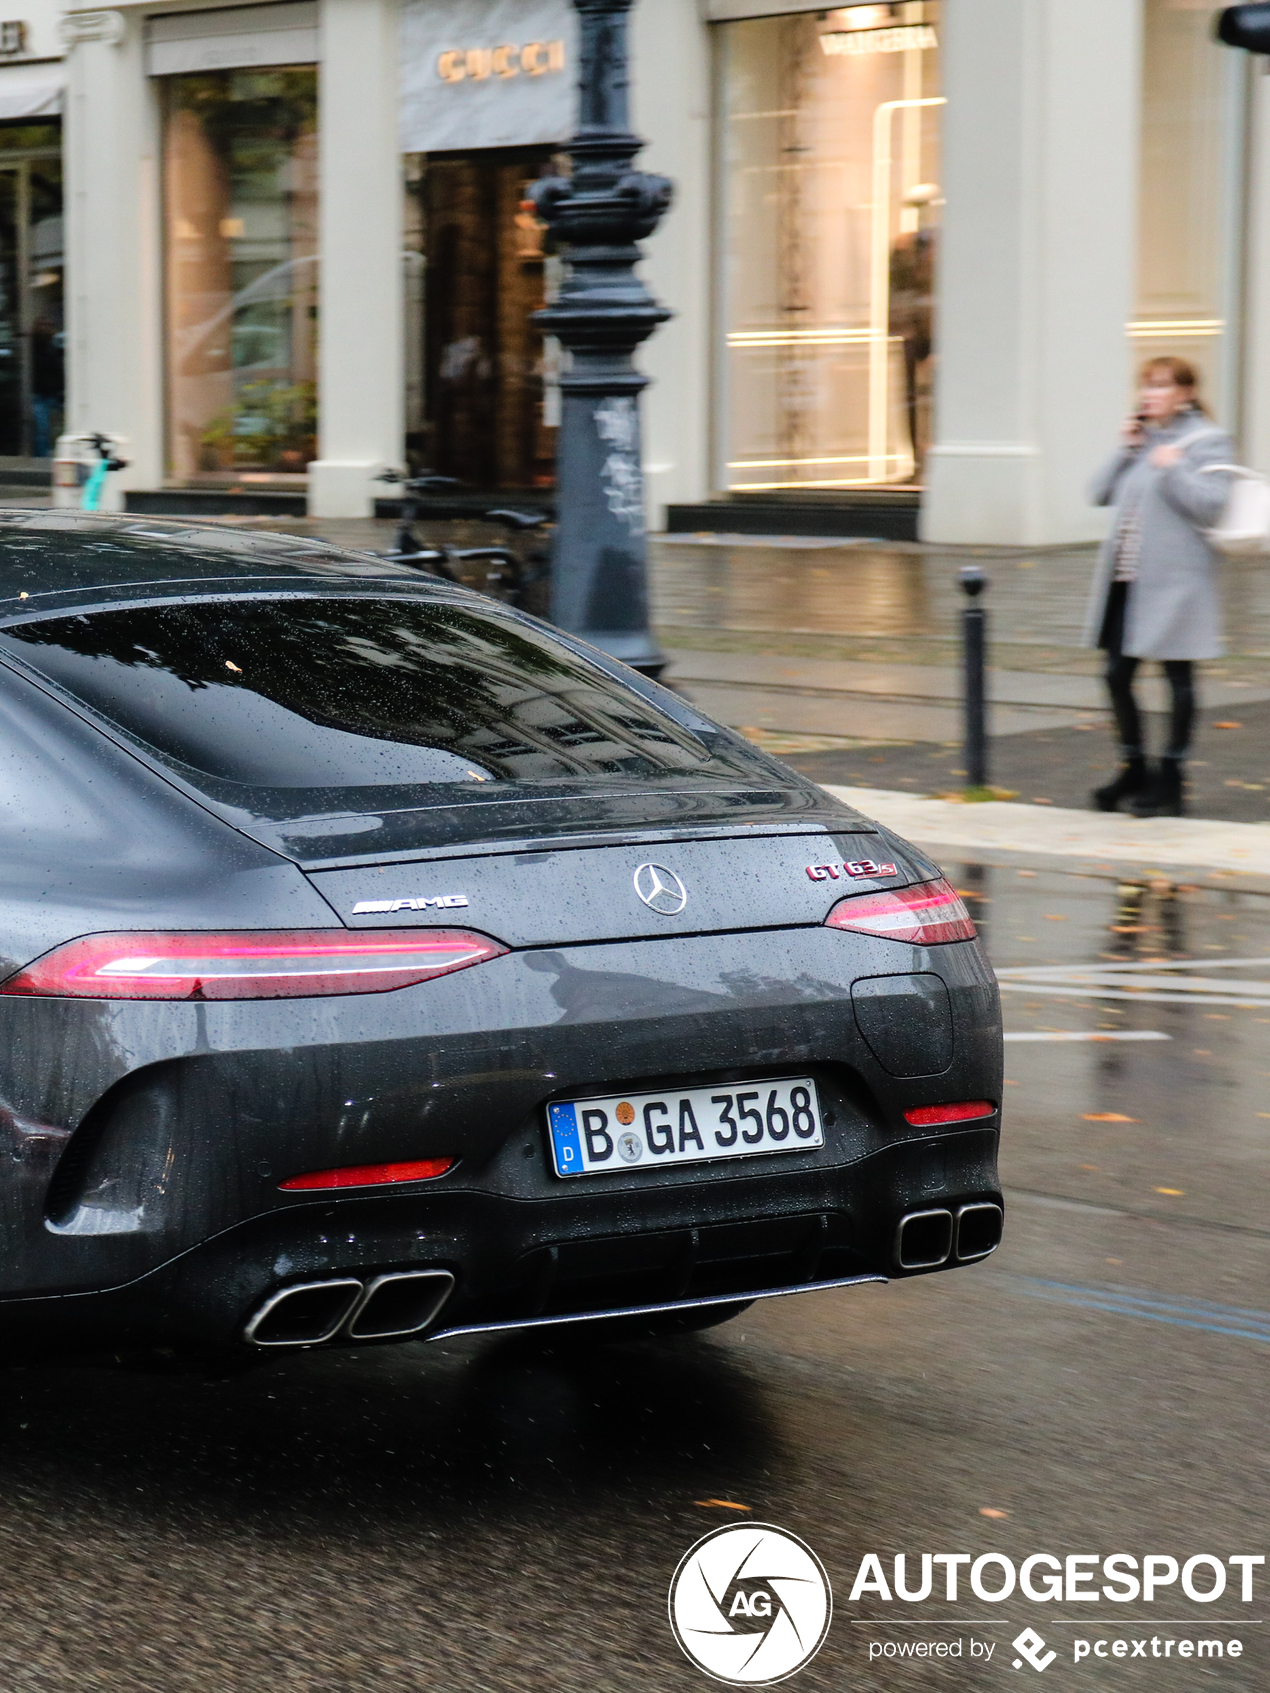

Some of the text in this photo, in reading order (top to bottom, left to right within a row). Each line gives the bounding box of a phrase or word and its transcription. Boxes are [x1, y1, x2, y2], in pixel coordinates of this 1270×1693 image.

[437, 41, 564, 83] GUCCI
[806, 863, 840, 880] GT
[843, 859, 879, 876] 63
[390, 894, 469, 913] AMG
[581, 1108, 614, 1162] B
[642, 1099, 704, 1155] GA
[711, 1086, 816, 1147] 3568
[564, 1146, 575, 1162] D
